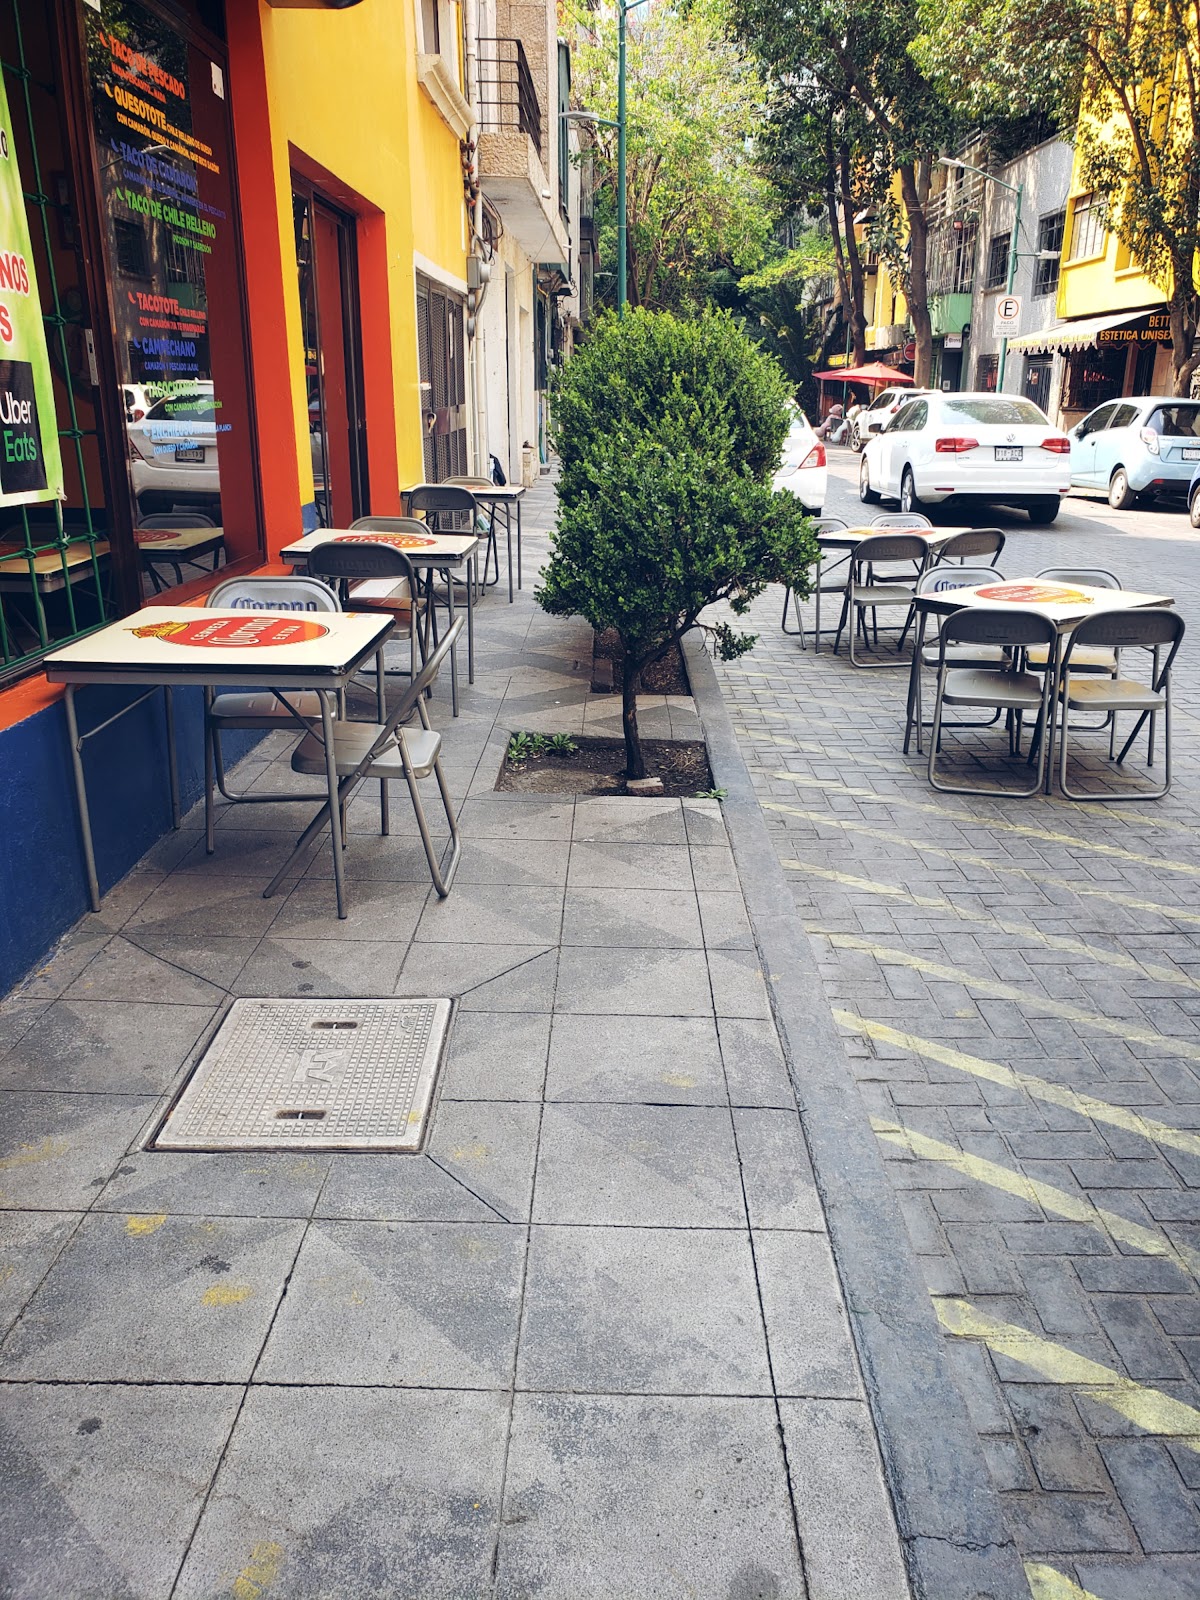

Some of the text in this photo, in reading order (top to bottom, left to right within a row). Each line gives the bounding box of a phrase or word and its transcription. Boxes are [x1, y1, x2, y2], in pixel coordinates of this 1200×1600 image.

[108, 34, 186, 101] TACO DE PESCADO
[113, 85, 168, 132] QUESOTOTE
[116, 112, 128, 126] CON
[119, 141, 198, 193] TACO DE CAMARÓN
[125, 188, 217, 240] TACO DE CHILE RELLENO
[136, 292, 180, 316] TACOTOTE
[1003, 301, 1014, 317] E
[139, 316, 150, 327] CON
[1099, 329, 1139, 341] ESTETICA
[142, 337, 197, 358] CAMPECHANO
[0, 391, 32, 425] Uber
[164, 403, 174, 413] CON
[3, 430, 38, 463] Eats
